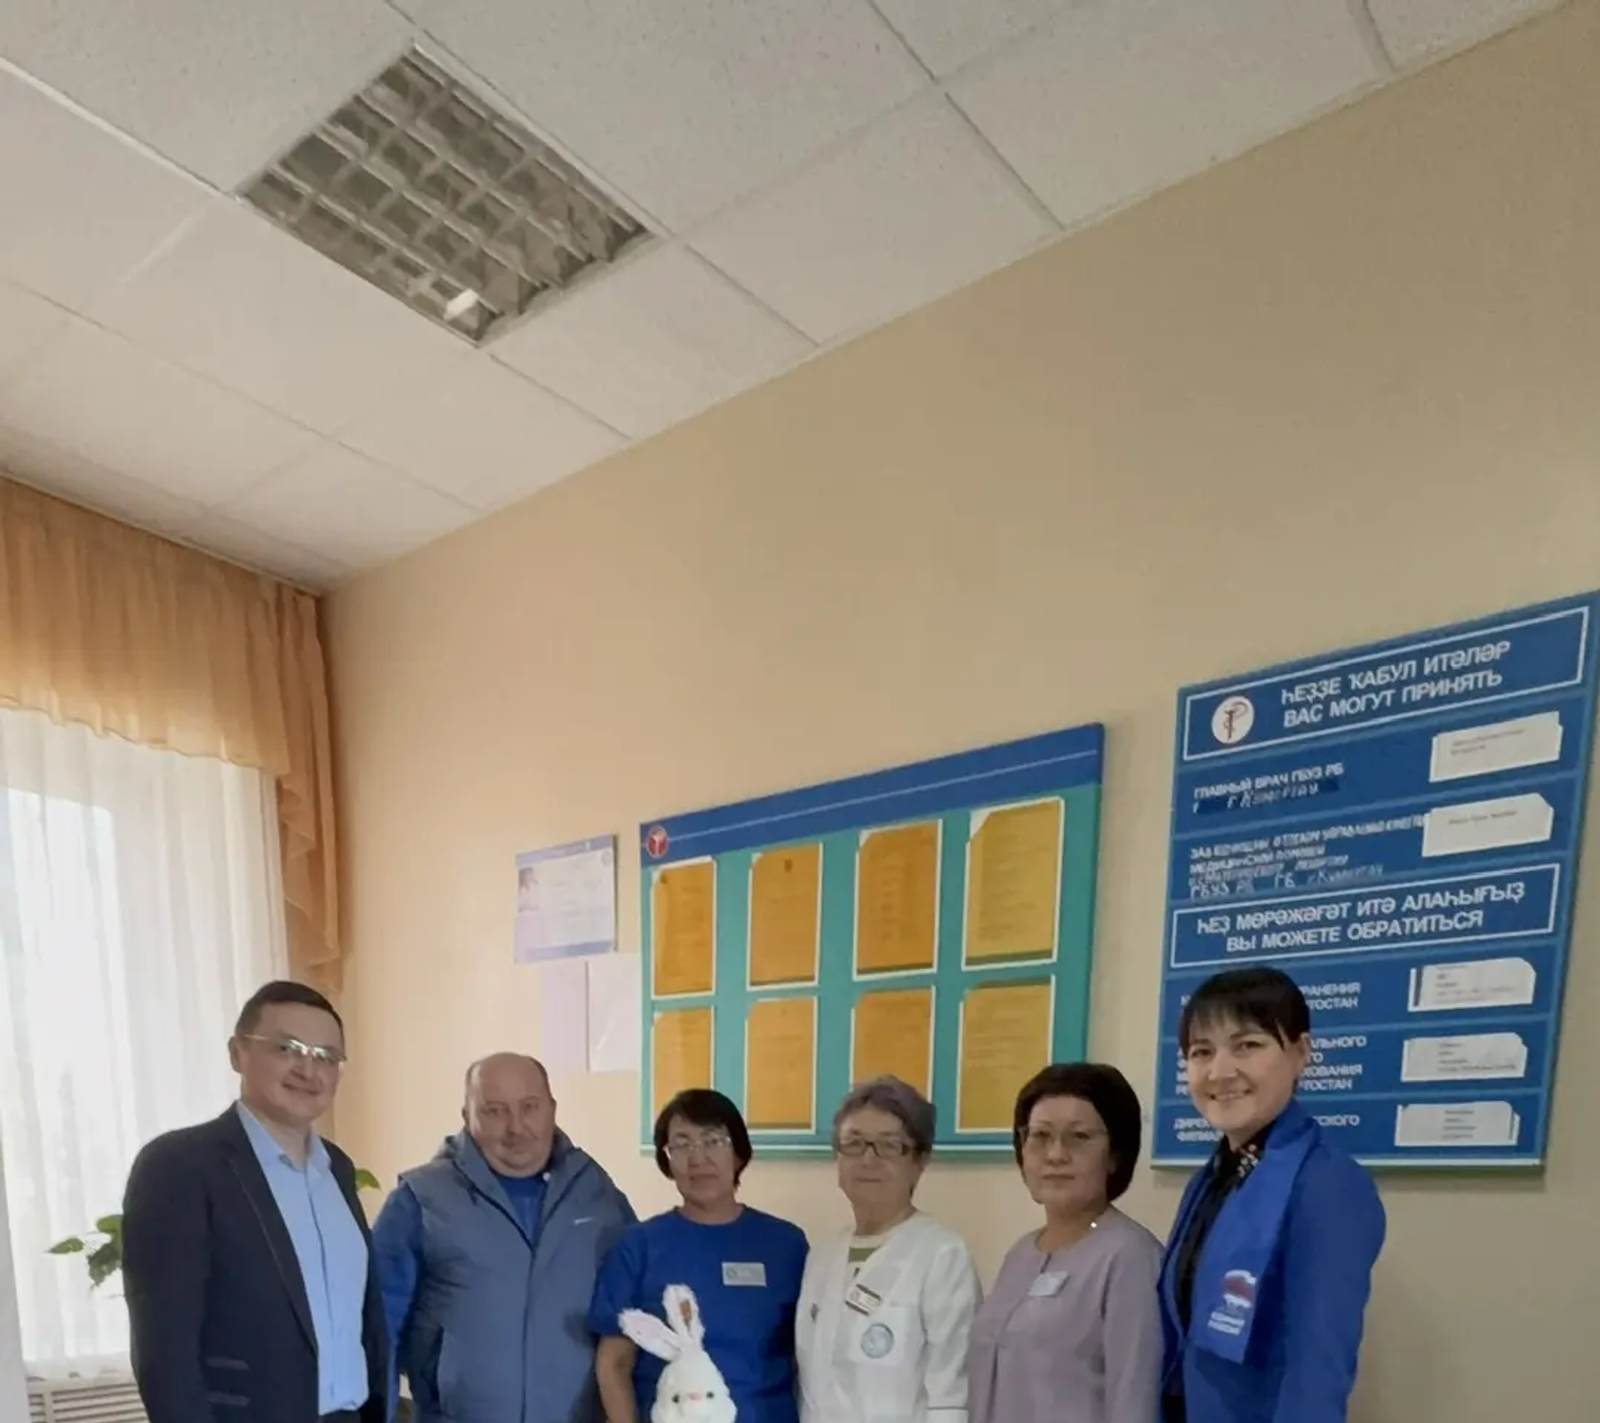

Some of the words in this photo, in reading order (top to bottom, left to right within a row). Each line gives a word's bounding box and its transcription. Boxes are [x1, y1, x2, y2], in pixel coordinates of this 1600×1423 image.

[1423, 641, 1510, 675] ИТӘЛӘР
[1283, 704, 1323, 728] ВАС
[1329, 688, 1395, 718] МОГУТ
[1402, 670, 1503, 703] ПРИНЯТЬ
[1194, 778, 1252, 799] ГЛАВНЫЙ
[1254, 773, 1289, 789] ВРАЧ
[1357, 898, 1396, 917] ИТӘ
[1226, 936, 1256, 952] ВЫ
[1261, 926, 1341, 949] МОЖЕТЕ
[1347, 910, 1484, 940] ОБРАТИТЬСЯ
